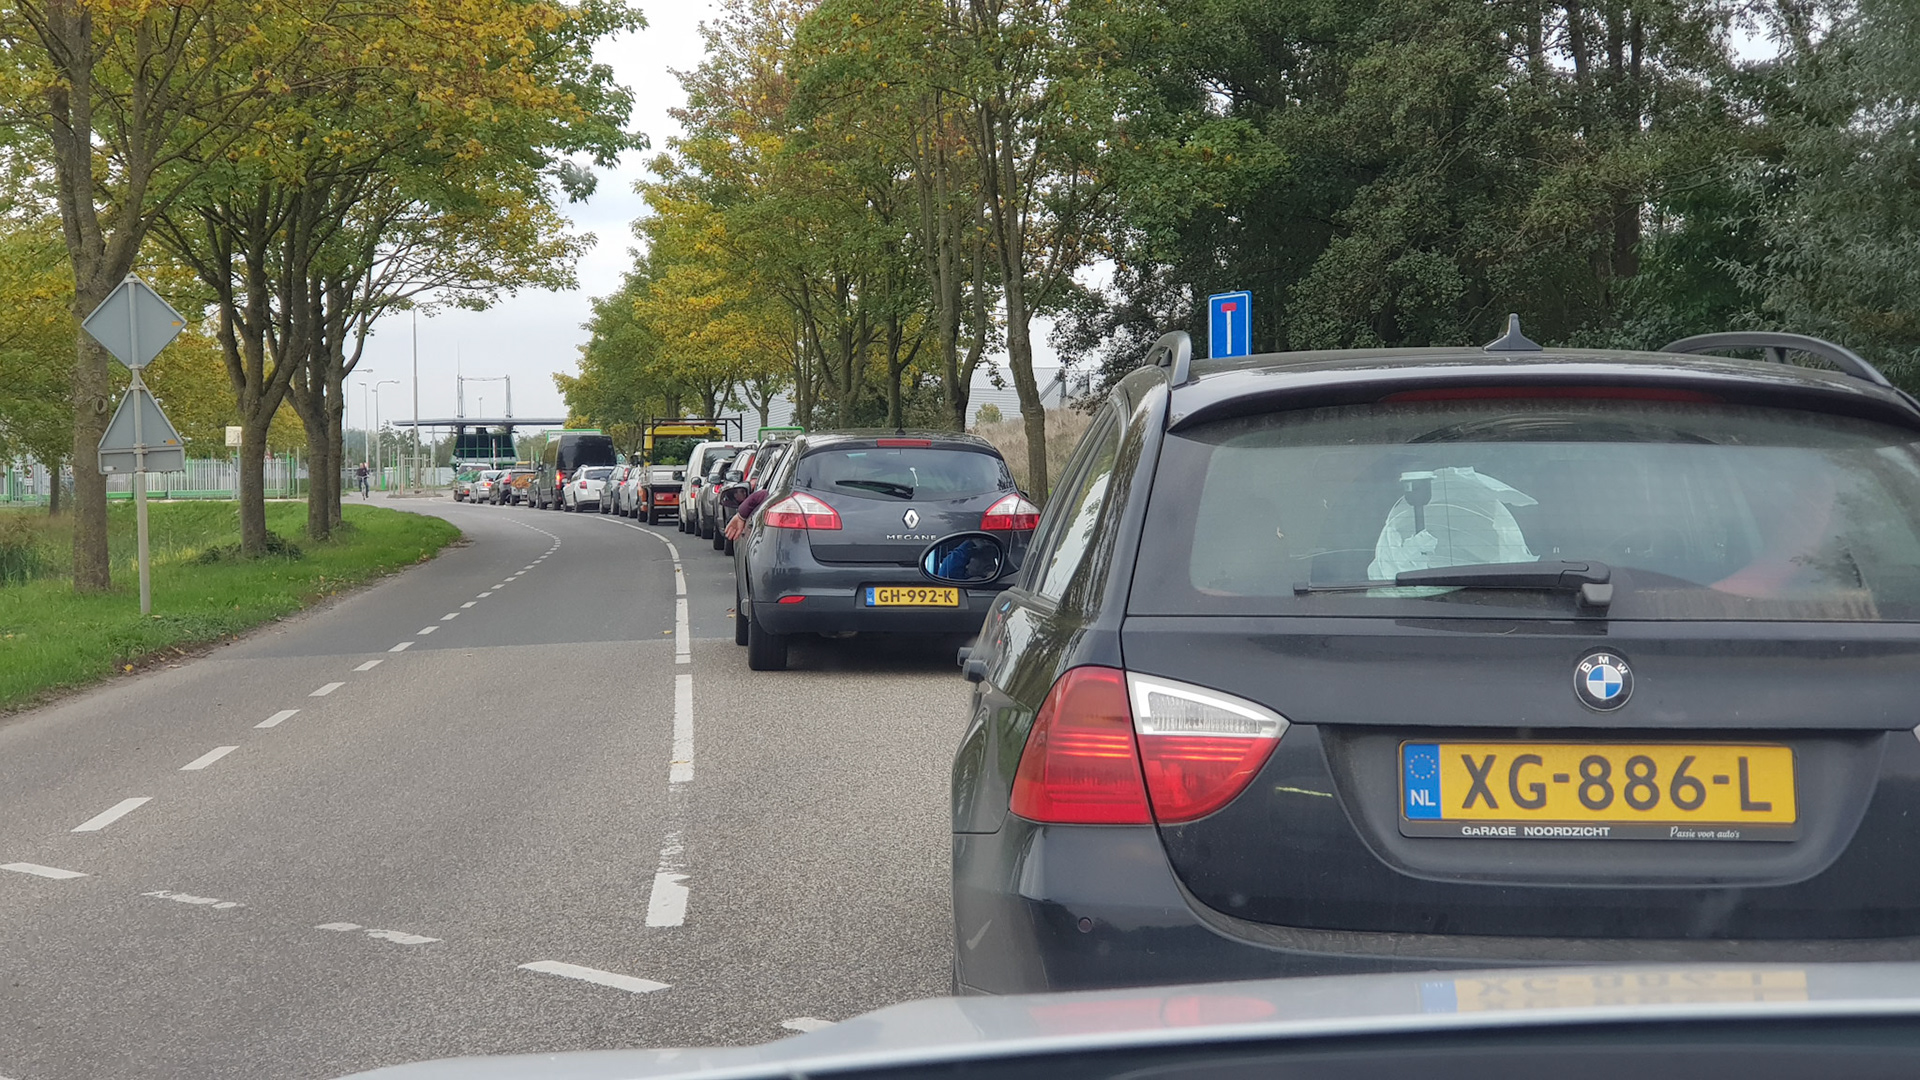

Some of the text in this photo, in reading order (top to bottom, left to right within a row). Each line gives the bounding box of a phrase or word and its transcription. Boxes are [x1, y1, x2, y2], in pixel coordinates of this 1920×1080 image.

[879, 589, 953, 604] GH-992-K
[1580, 655, 1628, 675] BMW
[1461, 753, 1772, 812] XG-886-L
[1410, 789, 1436, 806] NL
[1461, 826, 1611, 837] GARAGE NOORDZICHT
[1670, 826, 1740, 838] Passie voor auto's
